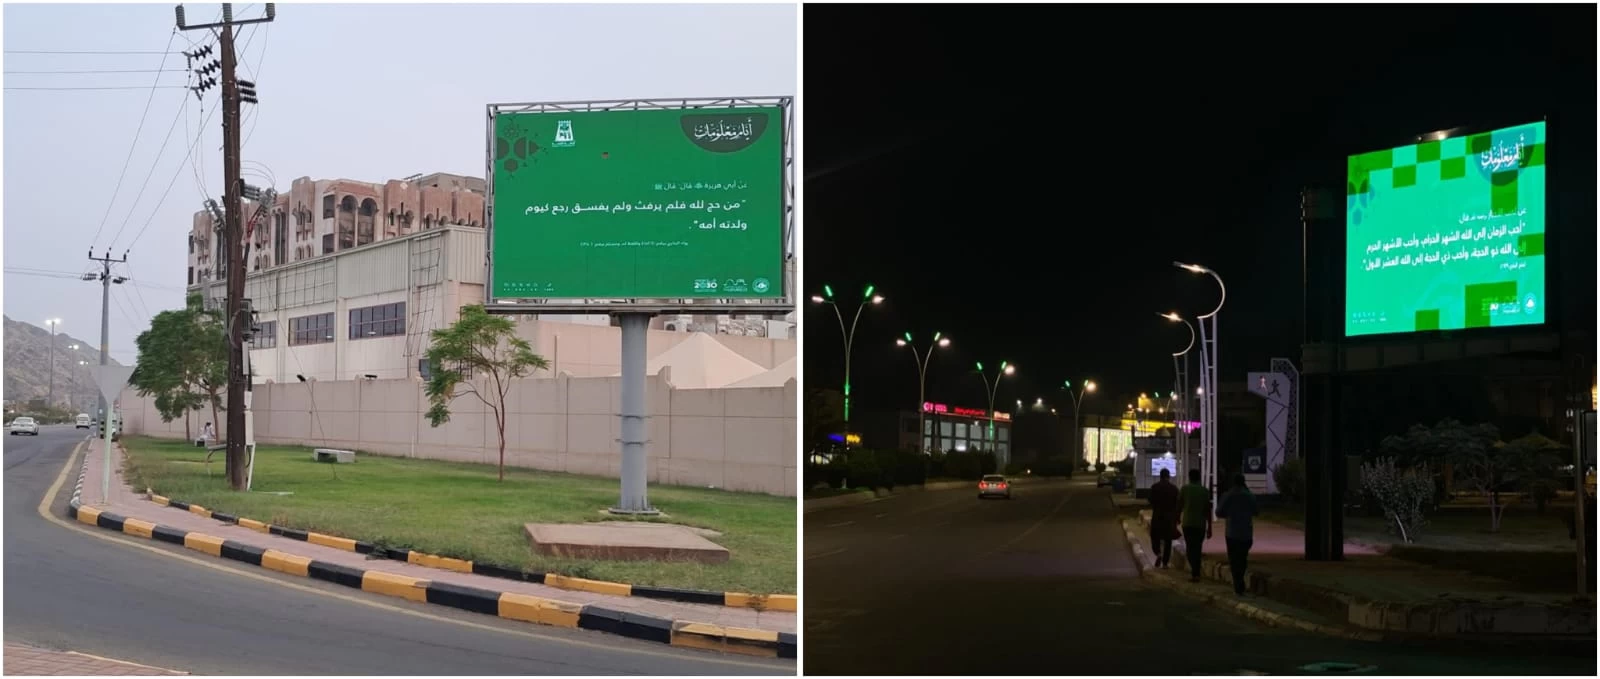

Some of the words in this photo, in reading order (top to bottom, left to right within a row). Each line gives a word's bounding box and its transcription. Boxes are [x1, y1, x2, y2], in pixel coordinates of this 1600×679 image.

[723, 179, 736, 191] أبي
[737, 180, 748, 190] عن
[524, 203, 549, 216] كيوم
[551, 203, 569, 216] رجع
[612, 201, 632, 214] ولم
[634, 200, 662, 213] يرفث
[665, 199, 687, 214] فلم
[689, 199, 704, 209] لله
[706, 201, 721, 213] حج
[719, 219, 748, 231] ولدته
[1441, 230, 1460, 246] الشهر
[1460, 228, 1473, 241] الله
[1473, 226, 1487, 241] إلى
[1487, 224, 1507, 240] الزمان
[1382, 237, 1403, 253] الأشهر
[1402, 231, 1420, 248] وأحب
[1366, 239, 1382, 256] الحرم
[1451, 244, 1469, 261] وأحب
[1490, 245, 1499, 258] ذو
[1500, 242, 1512, 255] الله
[1381, 255, 1400, 270] العشر
[1400, 253, 1412, 266] الله
[1411, 251, 1424, 267] إلى
[1424, 250, 1440, 264] الحجة
[1440, 250, 1451, 265] ذي
